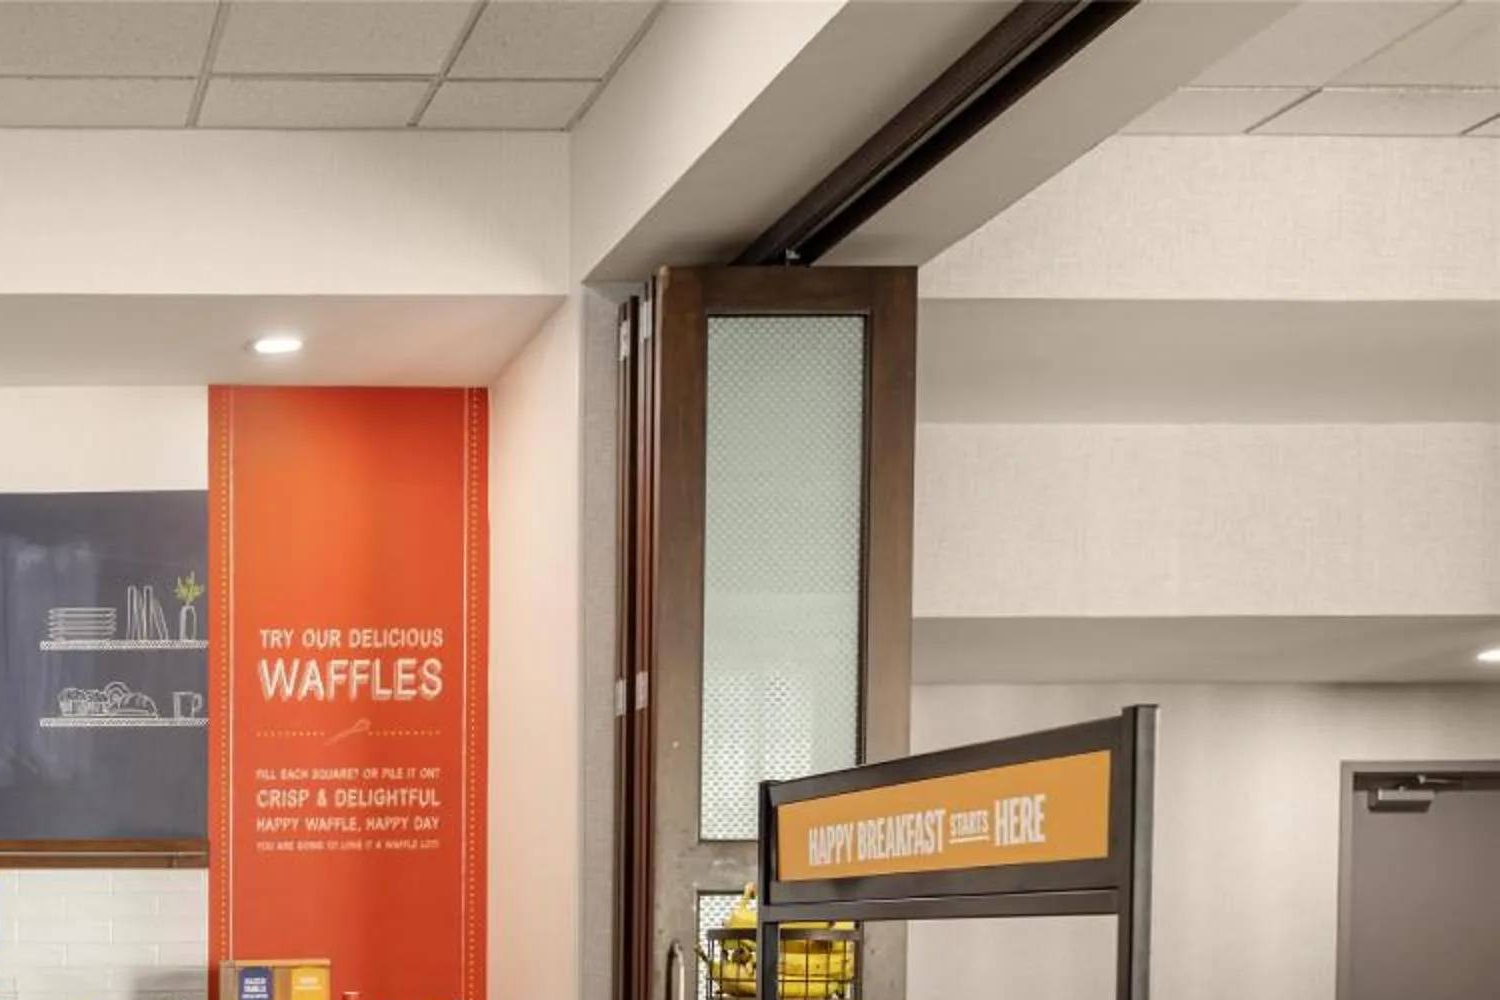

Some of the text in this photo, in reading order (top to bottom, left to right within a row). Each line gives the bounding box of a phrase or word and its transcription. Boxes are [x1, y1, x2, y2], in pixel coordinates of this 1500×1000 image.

[260, 628, 443, 648] TRY OUR DELICIOUS
[260, 657, 443, 701] WAFFLES
[256, 768, 276, 780] FILL
[280, 768, 308, 780] EACH
[363, 768, 379, 780] OR
[382, 768, 404, 780] PILE
[407, 768, 416, 780] IT
[257, 789, 441, 807] CRISP & DELIGHTFUL
[257, 816, 440, 832] HAPPY WAFFLE, HAPPY DAY
[809, 794, 1046, 866] HAPPY BREAKFAST STARTS HERE
[257, 841, 275, 850] YOU
[277, 841, 294, 850] ARE
